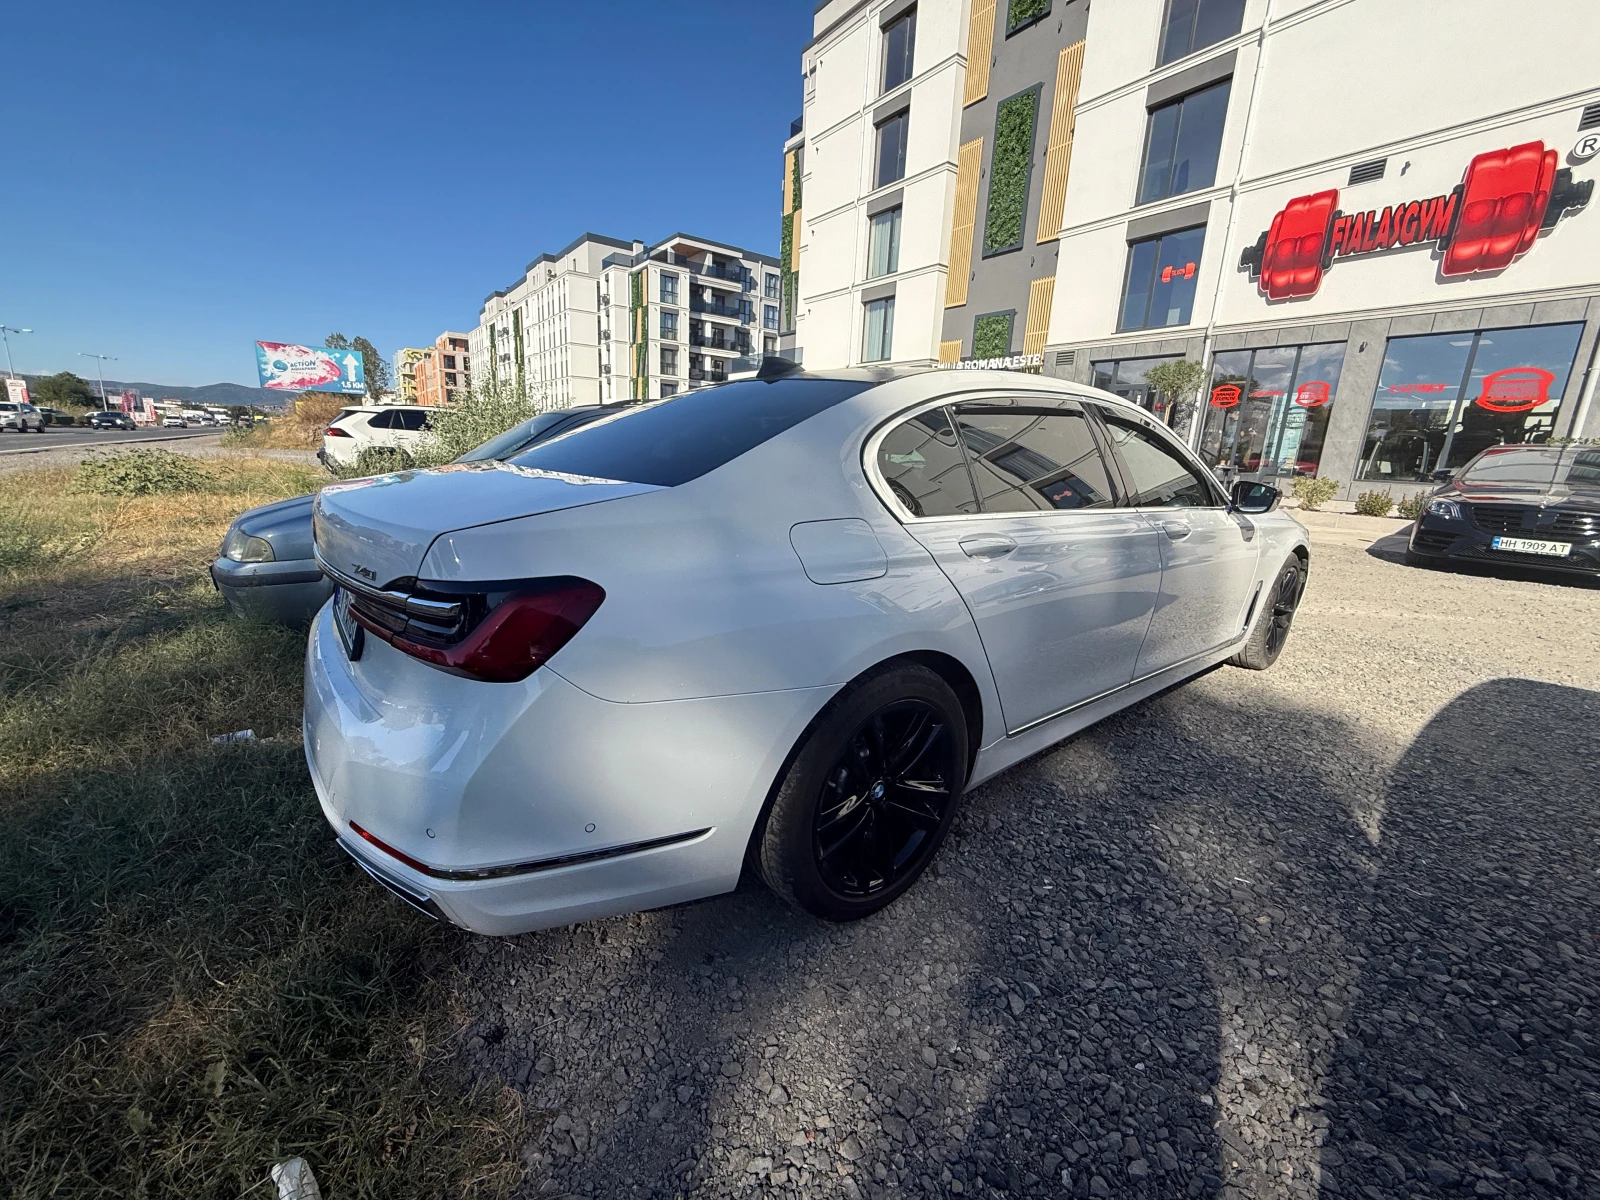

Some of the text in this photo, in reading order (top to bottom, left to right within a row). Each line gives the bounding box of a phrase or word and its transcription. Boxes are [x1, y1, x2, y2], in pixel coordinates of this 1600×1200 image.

[1328, 193, 1458, 257] FIALASGYM
[352, 381, 364, 389] KM
[1500, 539, 1568, 552] HH 1909 AT
